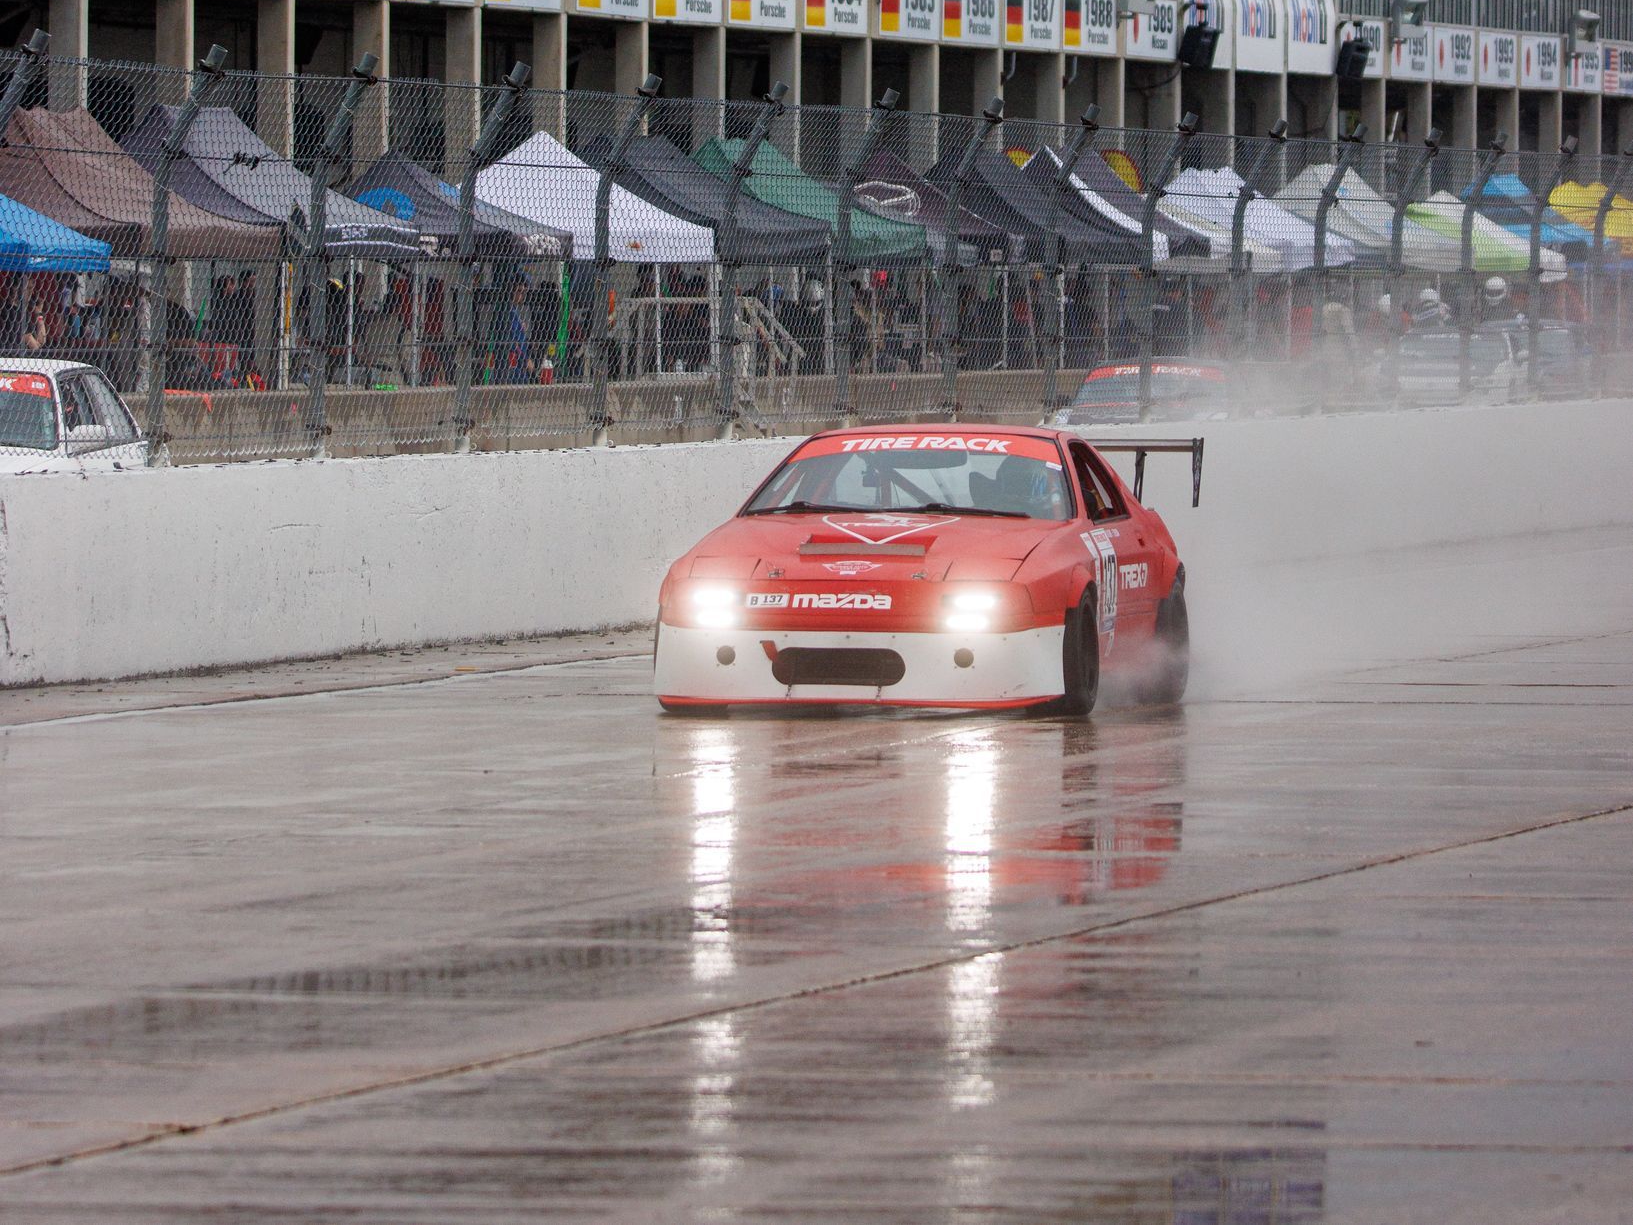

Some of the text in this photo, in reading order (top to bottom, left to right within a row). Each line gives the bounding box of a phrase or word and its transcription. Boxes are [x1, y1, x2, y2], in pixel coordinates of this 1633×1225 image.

[760, 0, 786, 18] Porsche
[834, 7, 858, 24] Porsche
[907, 13, 931, 30] Porsche
[969, 19, 991, 36] Porsche
[1148, 5, 1173, 34] 1989
[1450, 34, 1471, 60] 1992
[1494, 37, 1514, 63] 1993
[1537, 41, 1557, 67] 1994
[1619, 49, 1633, 74] 199
[841, 436, 1012, 453] TIRE RACK
[763, 595, 783, 603] 137
[792, 593, 893, 609] mazda
